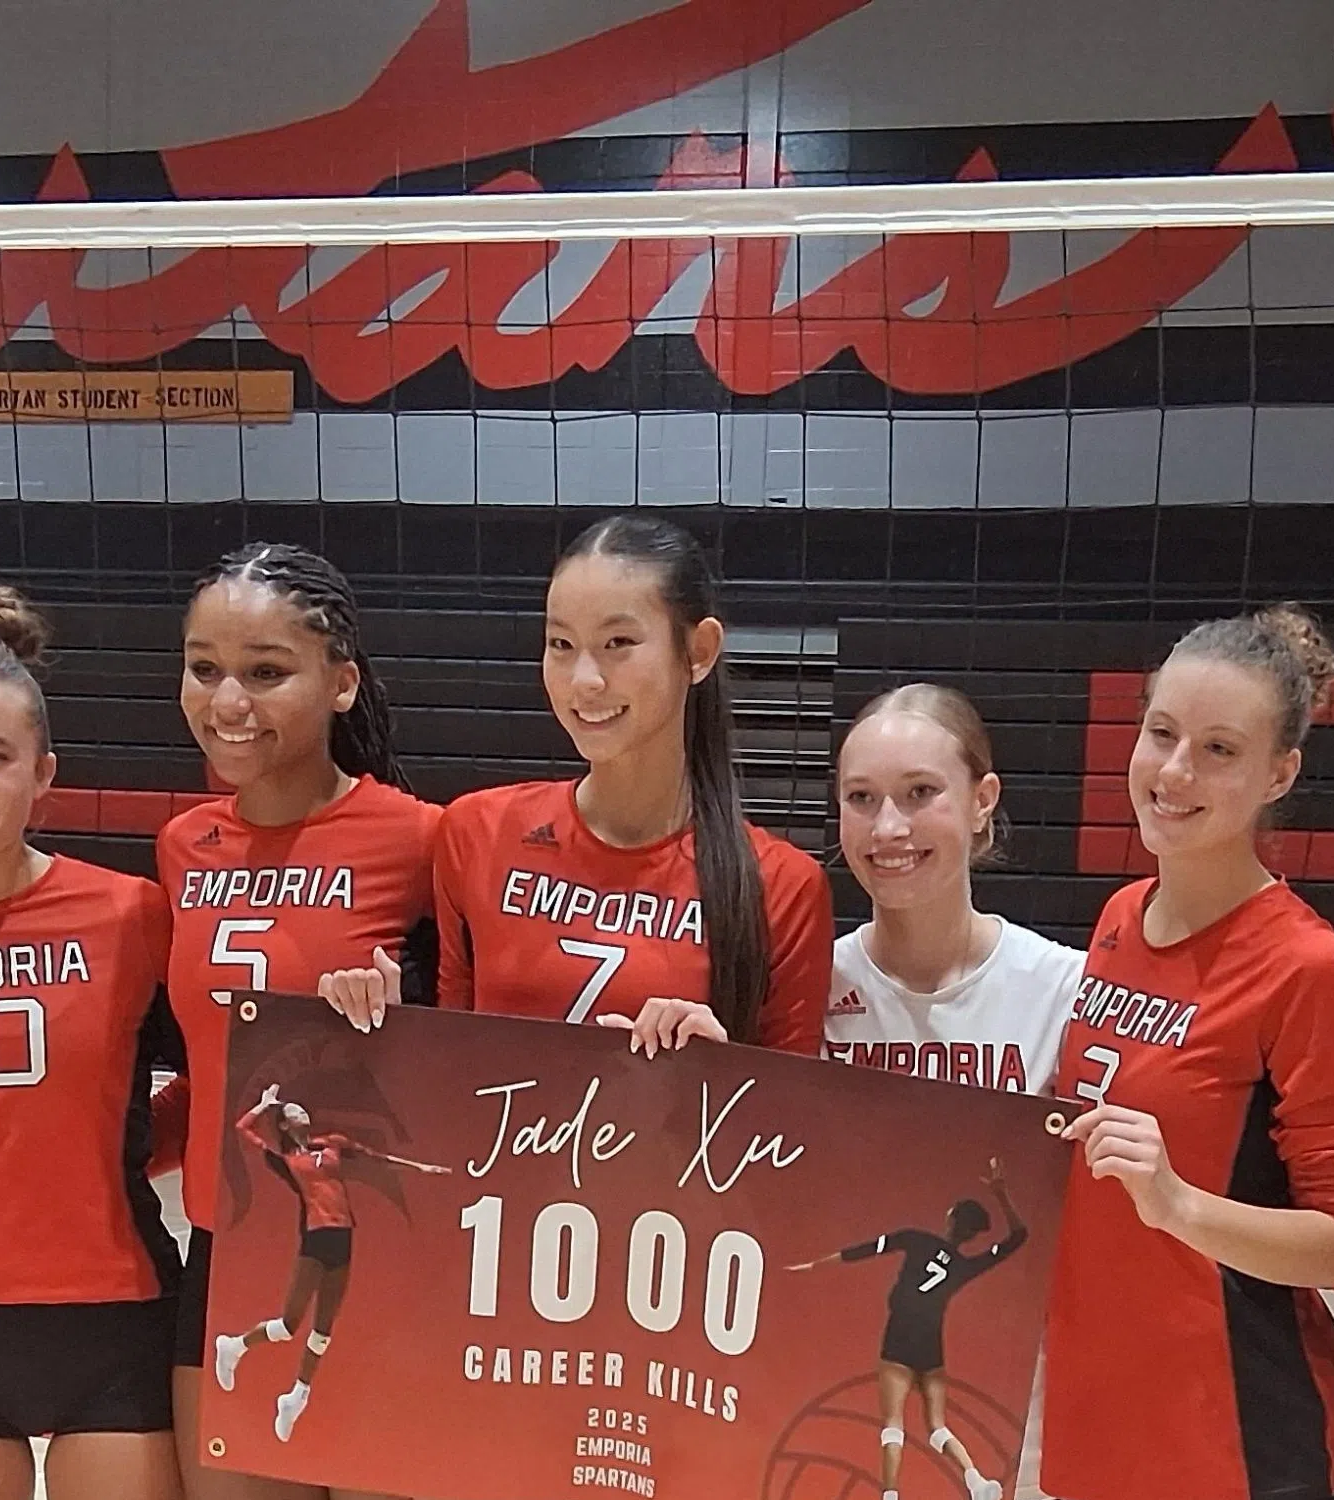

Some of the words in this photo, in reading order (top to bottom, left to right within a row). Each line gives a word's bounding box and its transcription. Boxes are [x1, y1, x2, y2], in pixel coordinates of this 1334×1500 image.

[57, 388, 140, 410] STUDENT
[155, 386, 235, 409] SECTION
[180, 867, 353, 909] EMPORIA
[501, 869, 704, 944] EMPORIA
[210, 919, 275, 1004] 5
[559, 938, 626, 1024] 7
[1070, 976, 1198, 1047] EMPORIA
[467, 1077, 636, 1188] Jade
[678, 1078, 804, 1192] Xu
[460, 1195, 765, 1356] 1000
[918, 1260, 948, 1292] 7
[464, 1345, 625, 1388] CAREER
[647, 1360, 739, 1423] KILLS
[576, 1436, 652, 1468] EMPORIA
[587, 1407, 648, 1435] 2025
[572, 1466, 656, 1500] SPARTANS
